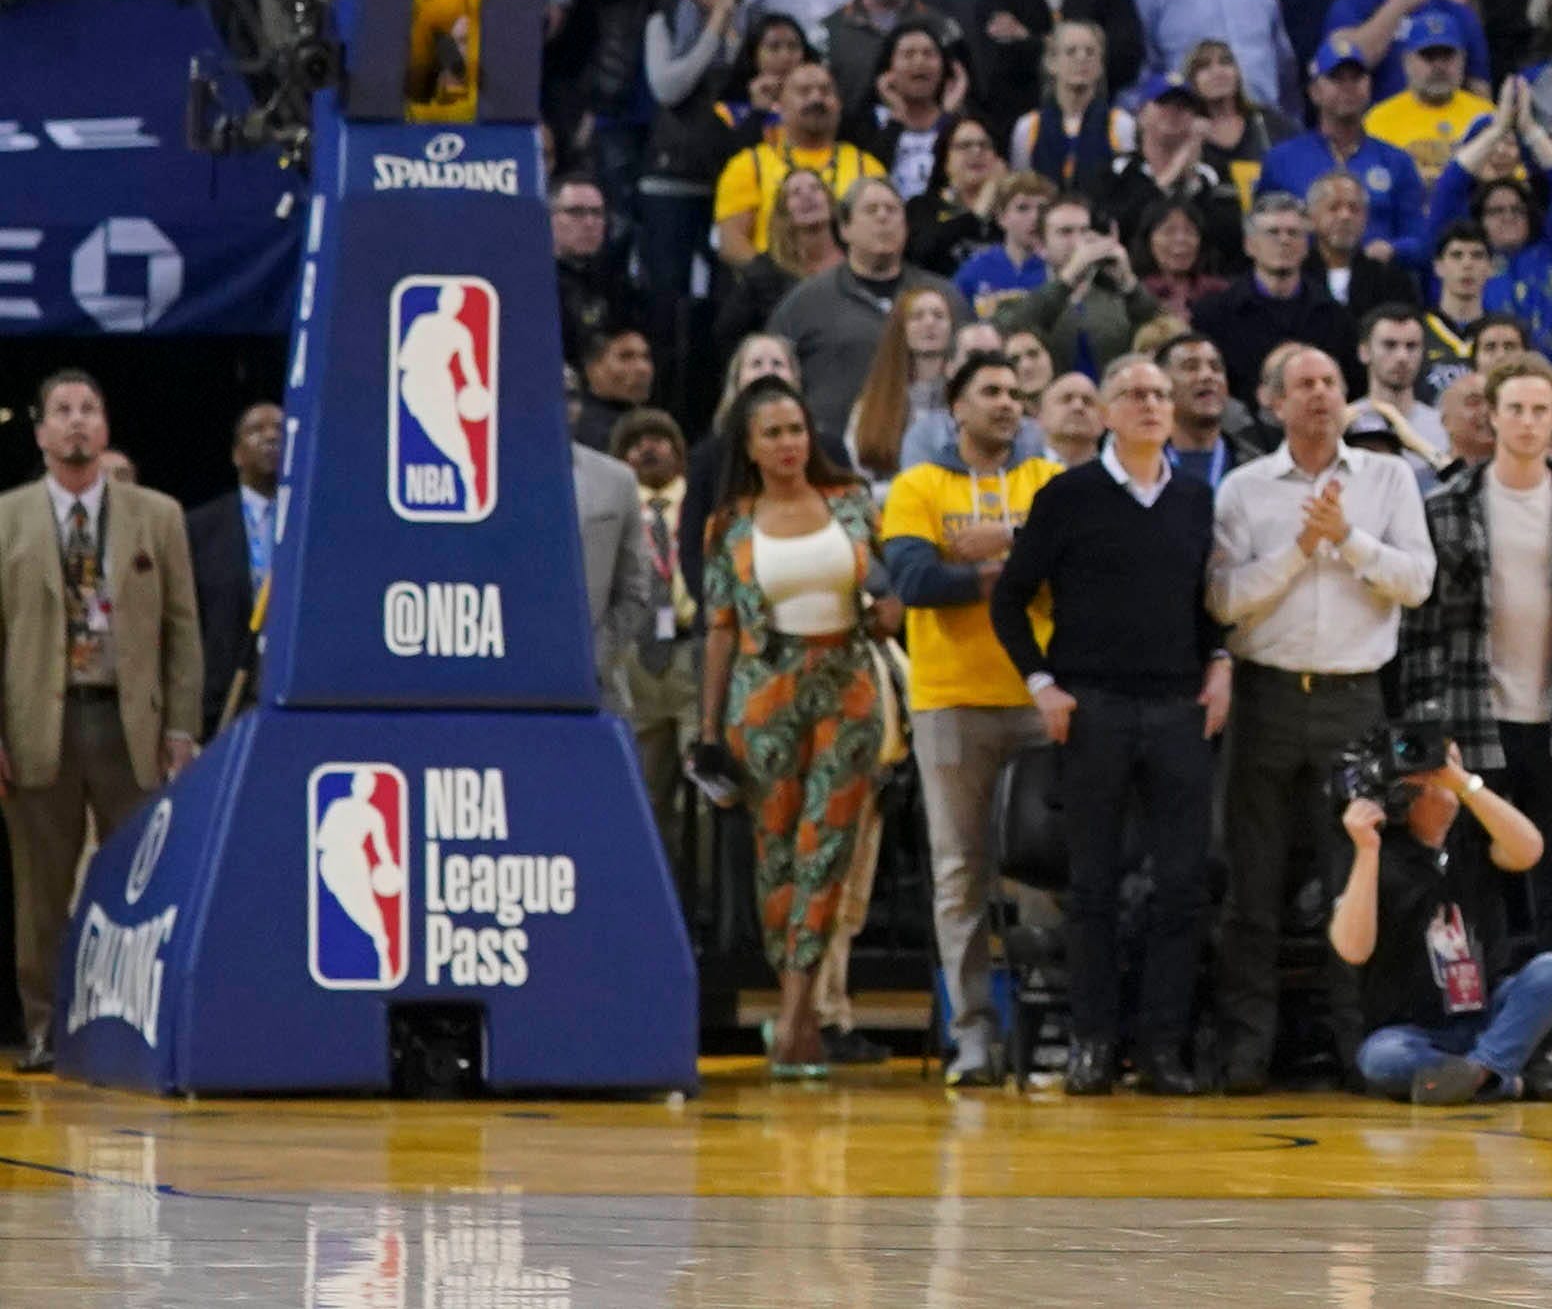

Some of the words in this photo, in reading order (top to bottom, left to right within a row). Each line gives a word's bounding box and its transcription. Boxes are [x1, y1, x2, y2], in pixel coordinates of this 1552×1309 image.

[373, 154, 519, 195] SPALDING
[406, 463, 458, 506] NBA
[383, 580, 506, 659] @NBA
[424, 767, 509, 840] NBA
[424, 841, 576, 928] League
[424, 912, 529, 987] Pass
